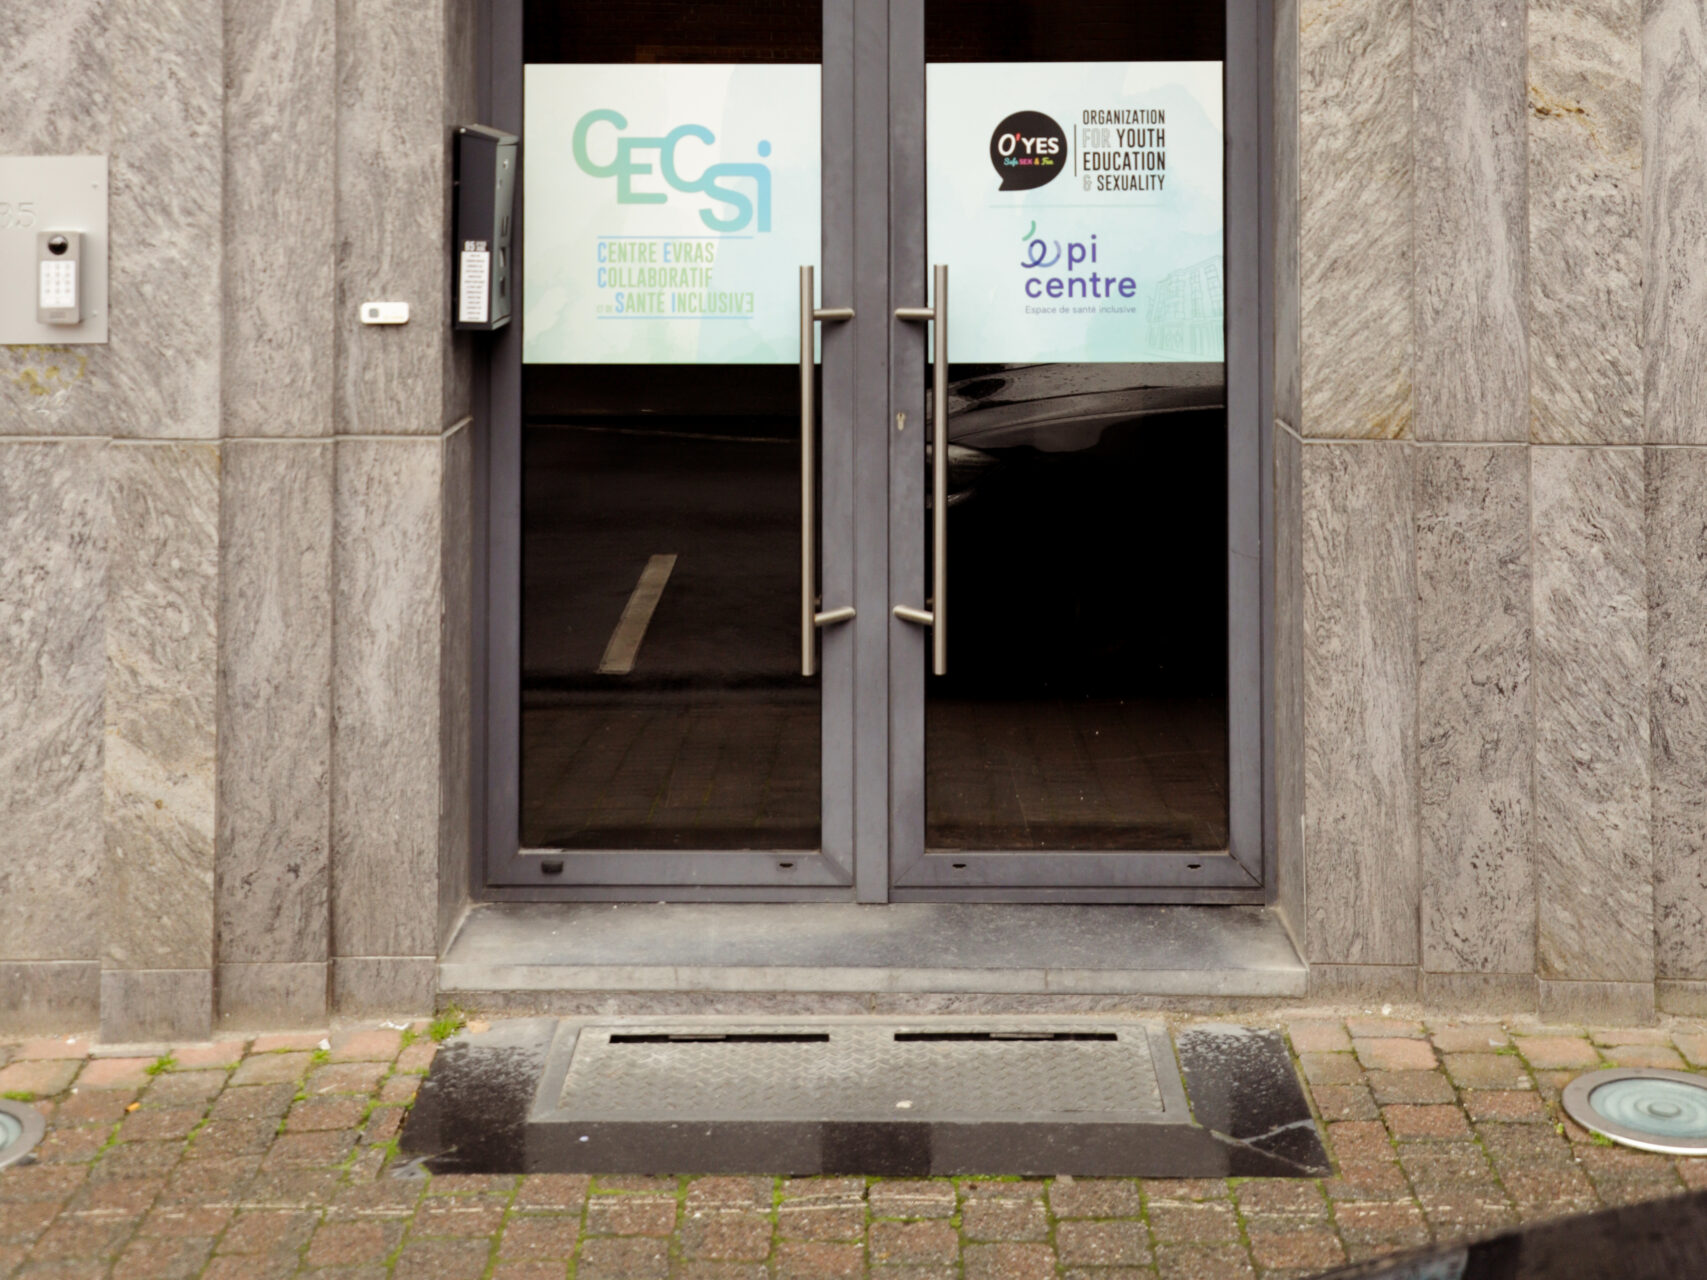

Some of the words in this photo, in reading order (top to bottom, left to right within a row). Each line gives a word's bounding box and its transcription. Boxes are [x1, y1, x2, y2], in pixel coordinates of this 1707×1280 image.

[1082, 109, 1166, 125] ORGANIZATION
[998, 133, 1060, 157] O'YES
[1082, 128, 1111, 148] FOR
[1117, 128, 1166, 148] YOUTH
[1083, 151, 1166, 171] EDUCATION
[1083, 175, 1092, 191] &
[1097, 175, 1165, 191] SEXUALITY
[597, 242, 657, 263] CENTRE
[664, 242, 714, 263] EVRAS
[597, 267, 713, 288] COLLABORATIF
[1025, 272, 1137, 299] centre
[615, 289, 665, 313] SANTÉ
[1025, 305, 1056, 315] Espace
[1059, 305, 1070, 314] de
[1072, 305, 1096, 314] santé
[1099, 305, 1137, 314] inclusive
